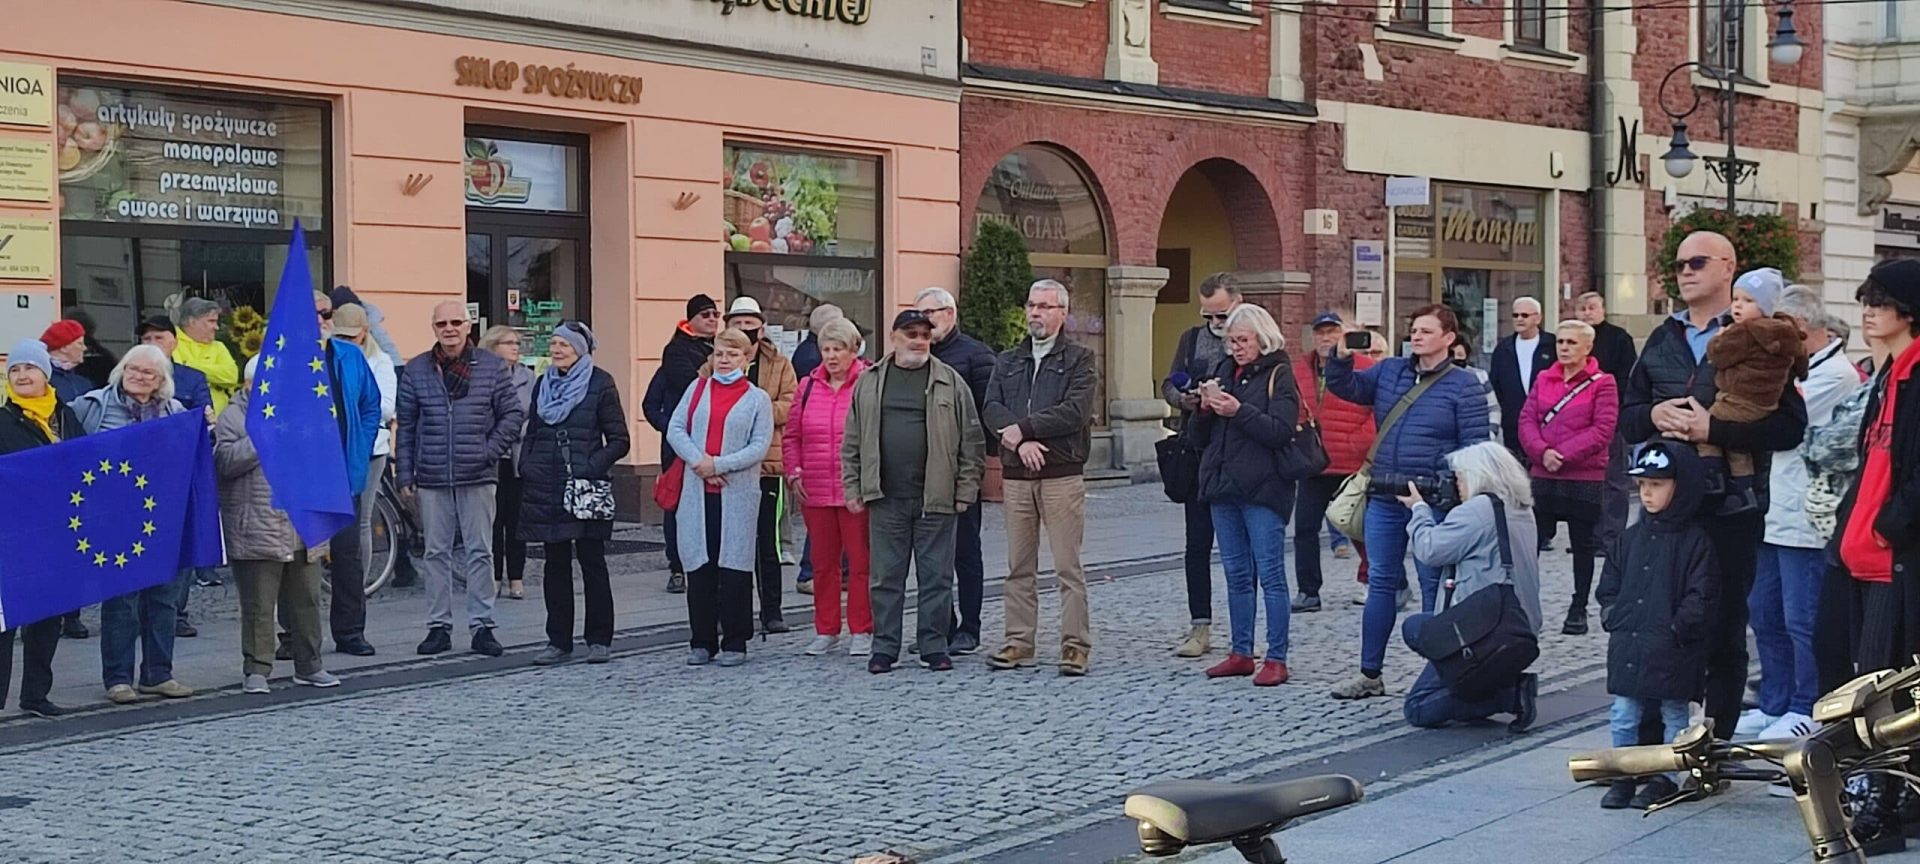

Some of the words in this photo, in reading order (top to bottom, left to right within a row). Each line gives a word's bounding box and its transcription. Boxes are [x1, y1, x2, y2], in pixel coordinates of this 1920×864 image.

[455, 56, 519, 91] SKLEP
[523, 62, 643, 105] SPOŻYWCZY
[97, 103, 176, 134] artykuły
[182, 110, 278, 139] spożywcze
[163, 142, 278, 167] monopolowe
[159, 171, 278, 197] przemysłowe
[117, 199, 179, 218] owoce
[185, 196, 191, 219] i
[197, 204, 279, 228] warzywa
[1323, 213, 1333, 231] 16
[1444, 206, 1538, 252] Monsun
